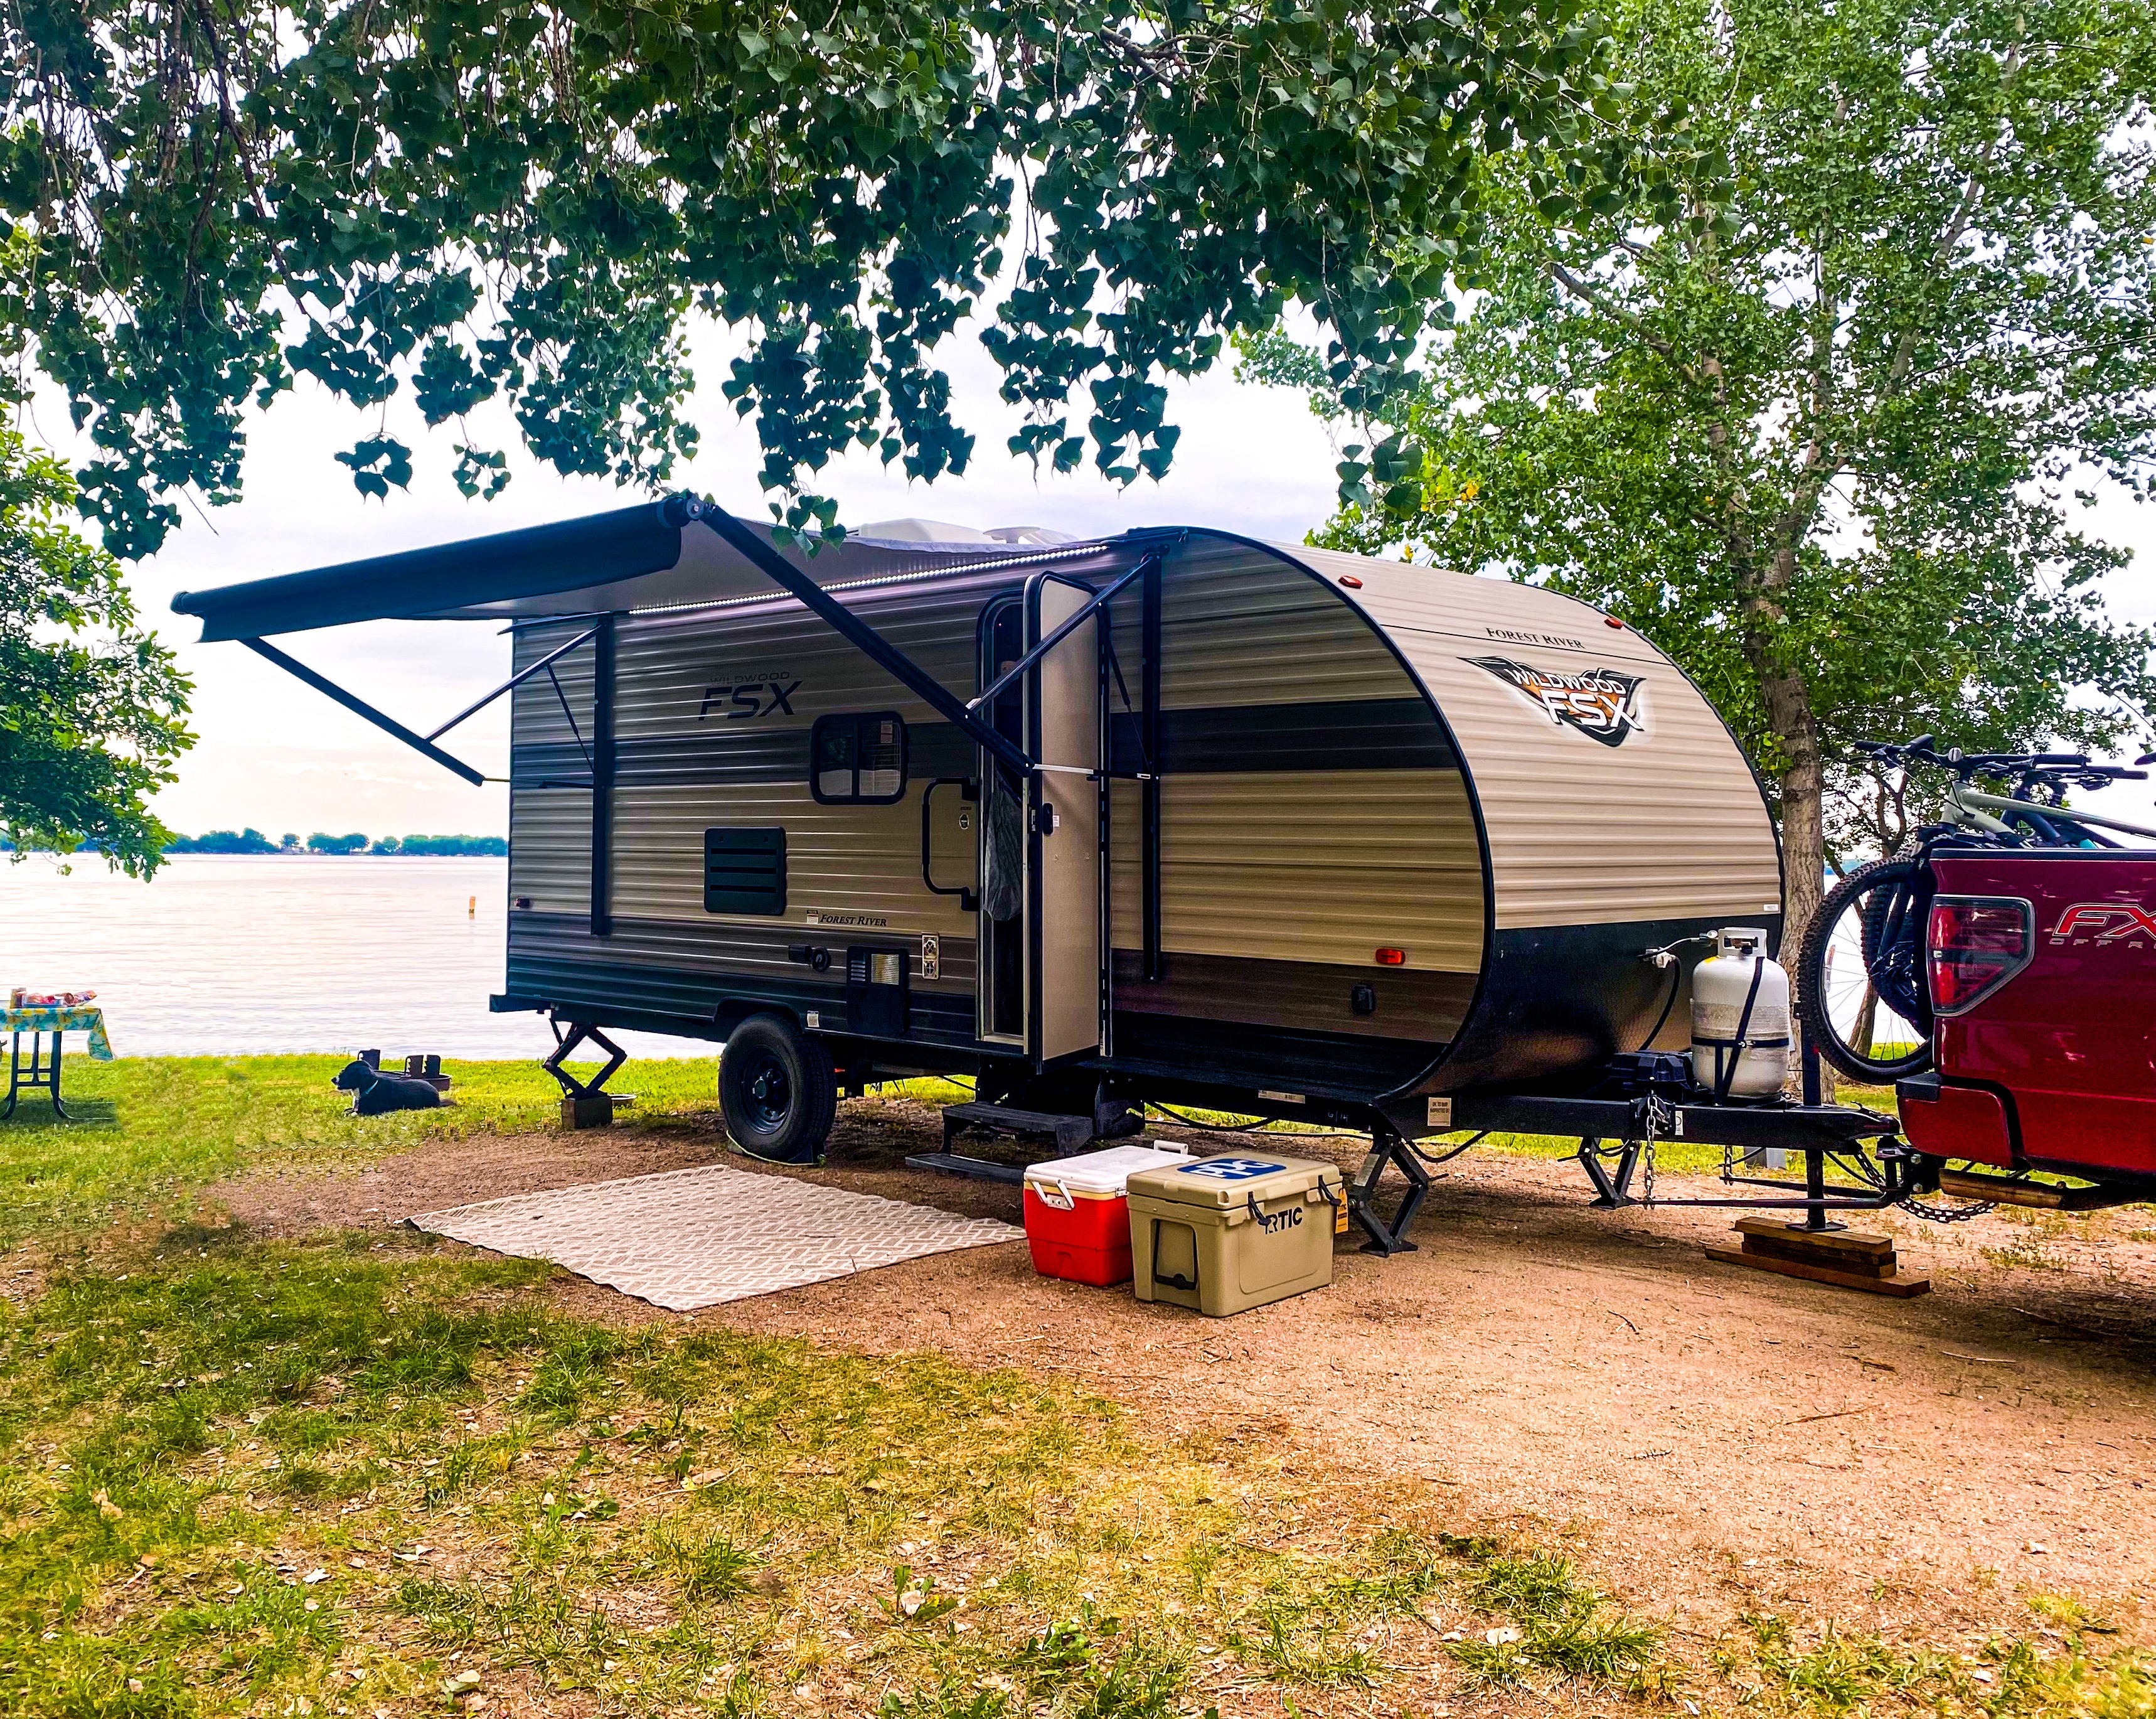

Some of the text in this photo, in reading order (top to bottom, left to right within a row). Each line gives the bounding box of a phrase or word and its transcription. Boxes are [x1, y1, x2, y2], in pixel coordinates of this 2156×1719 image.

[1485, 628, 1586, 649] FOREST RIVER
[710, 672, 790, 684] WILDWOOD
[1503, 668, 1626, 694] WILDWOOD
[698, 680, 803, 720] FSX
[1539, 689, 1645, 732] FSX
[819, 914, 887, 927] FOREST RIVER
[1265, 1206, 1303, 1235] RTIC
